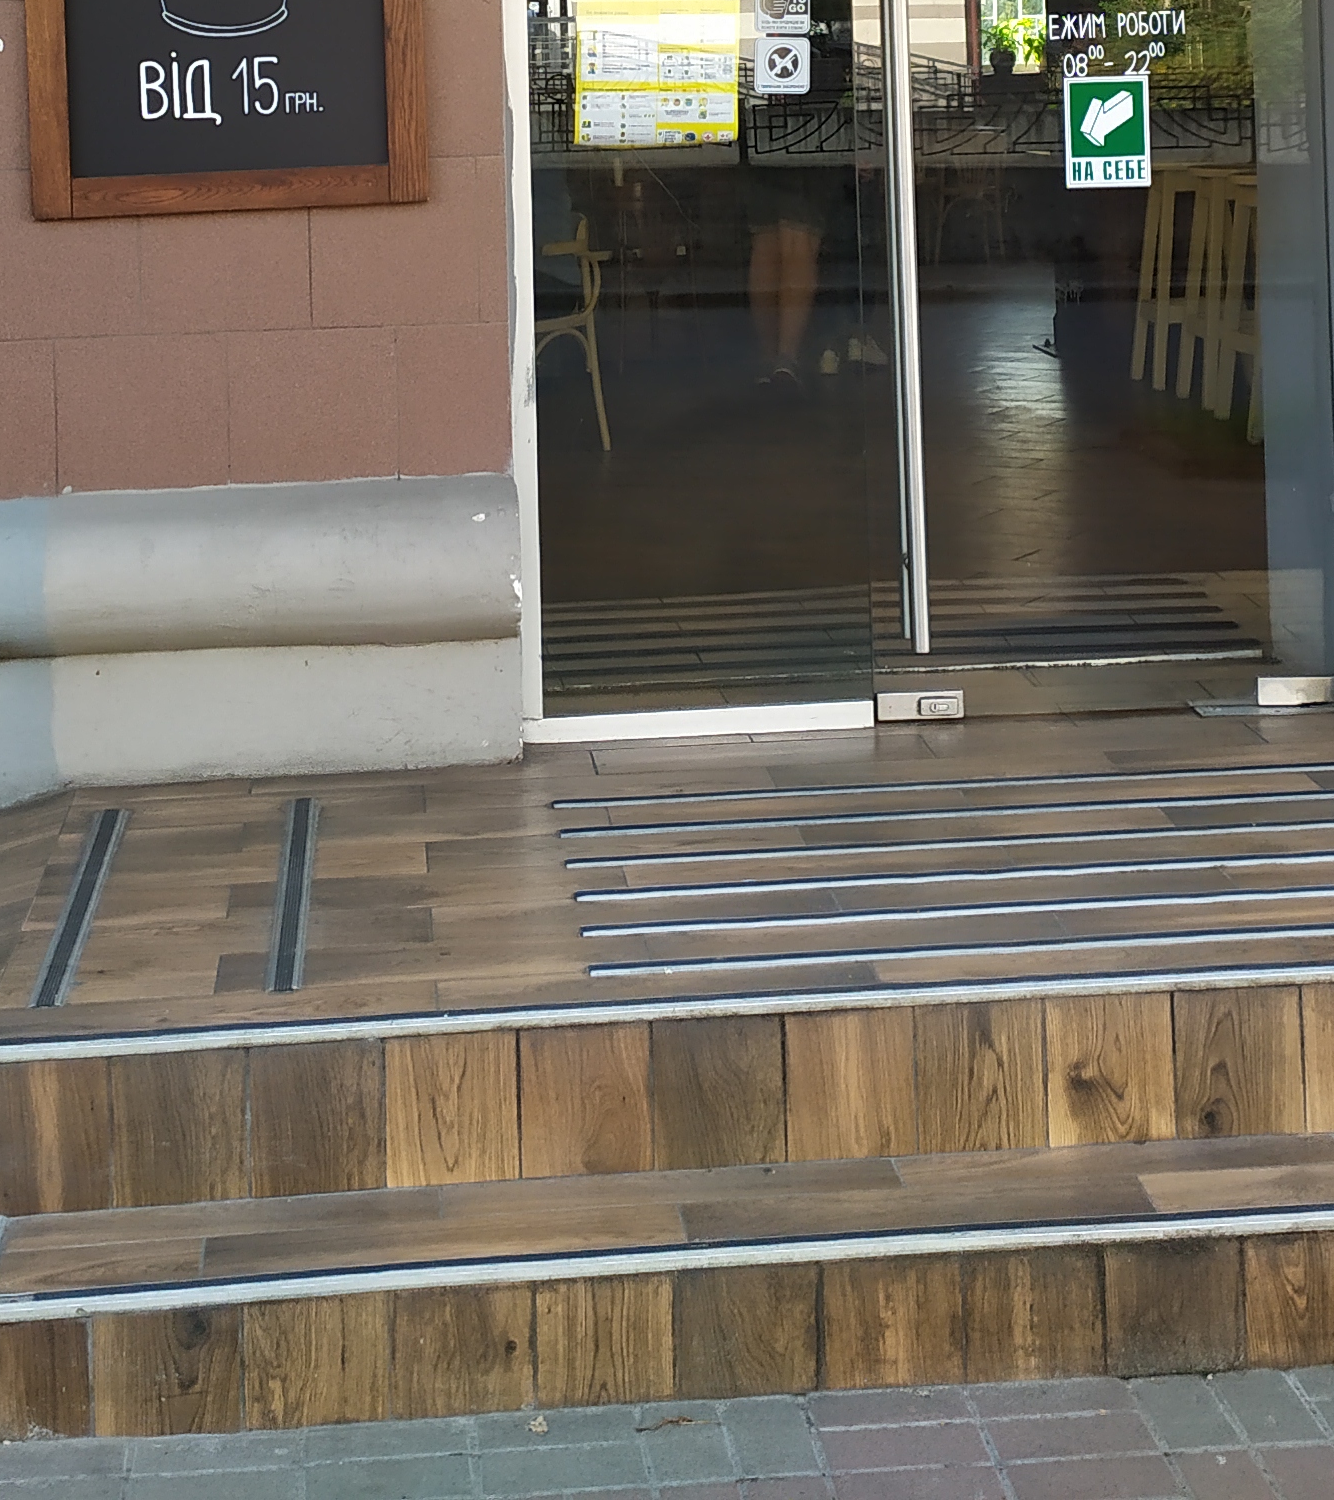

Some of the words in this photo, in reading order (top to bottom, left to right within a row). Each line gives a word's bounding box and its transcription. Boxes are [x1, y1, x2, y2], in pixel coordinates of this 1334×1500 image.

[789, 4, 805, 12] GO
[1118, 9, 1185, 38] РОБОТИ
[232, 56, 278, 115] 15
[1072, 161, 1094, 181] НА
[1103, 159, 1146, 180] СЕБЕ
